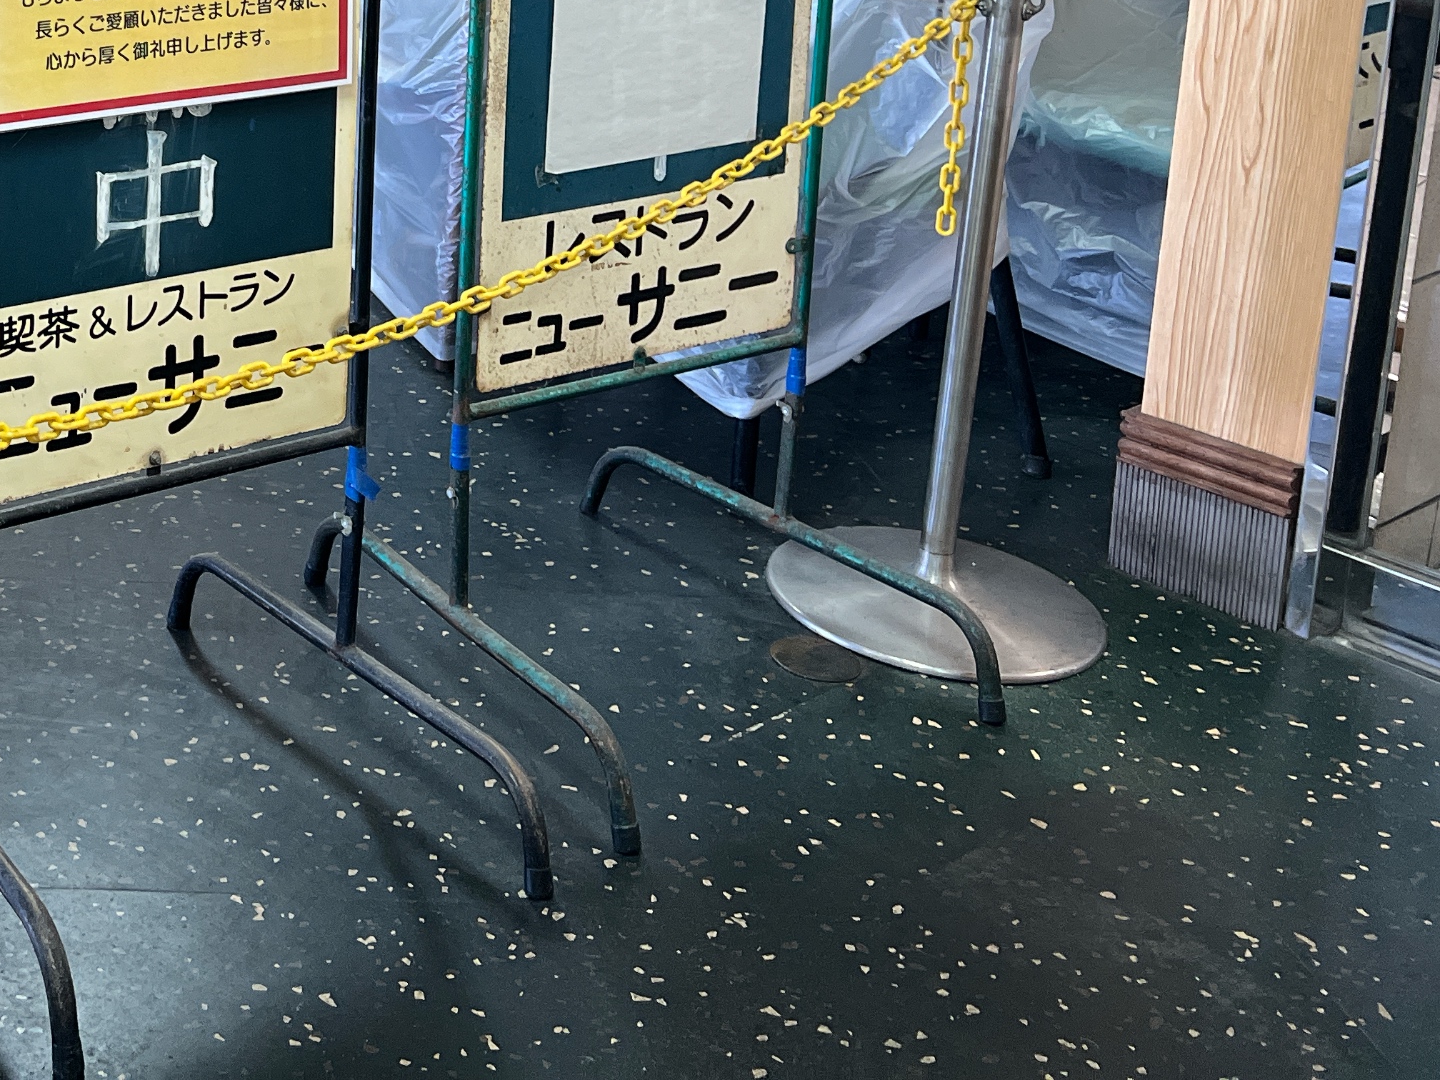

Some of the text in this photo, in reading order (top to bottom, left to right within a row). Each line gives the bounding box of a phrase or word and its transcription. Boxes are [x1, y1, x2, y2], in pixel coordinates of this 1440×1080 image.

[45, 28, 273, 71] 心から厚く御礼申し上げます。
[96, 130, 217, 277] 中
[545, 193, 754, 272] レストラン
[500, 265, 778, 365] ニューサニー
